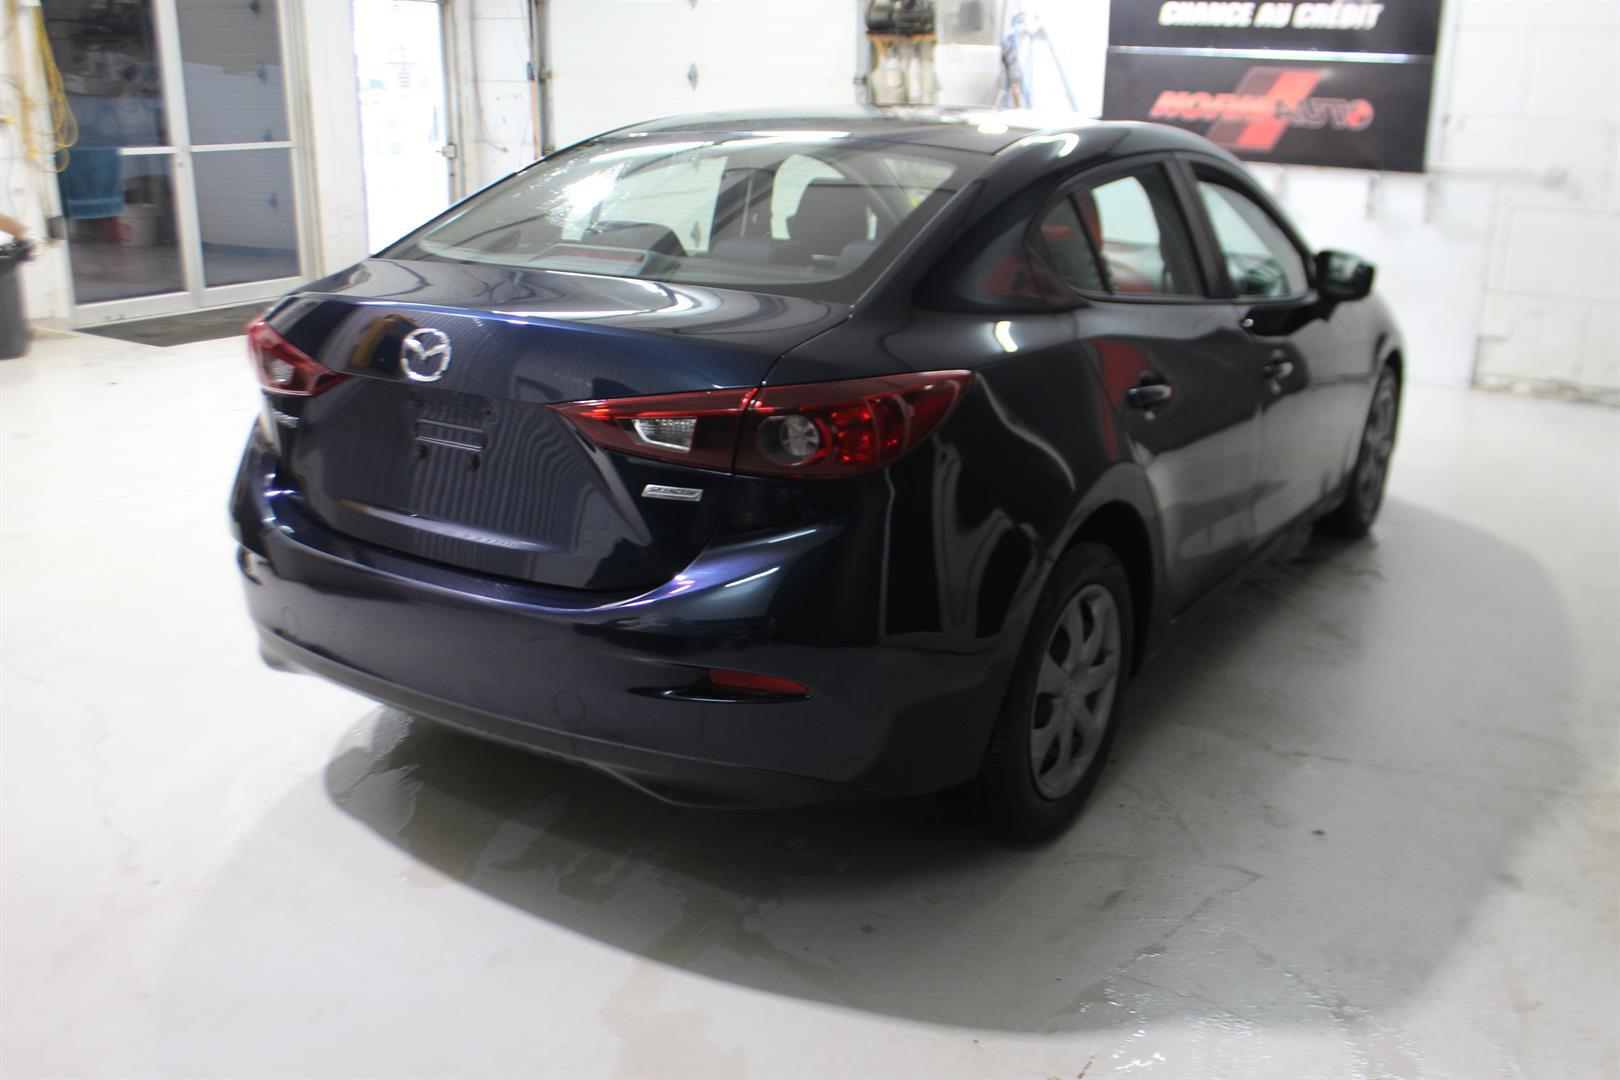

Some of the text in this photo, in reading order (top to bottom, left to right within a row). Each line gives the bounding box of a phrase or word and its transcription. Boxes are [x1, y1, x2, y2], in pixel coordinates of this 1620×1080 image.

[1158, 0, 1384, 30] CHANCE AU CRÉDIT
